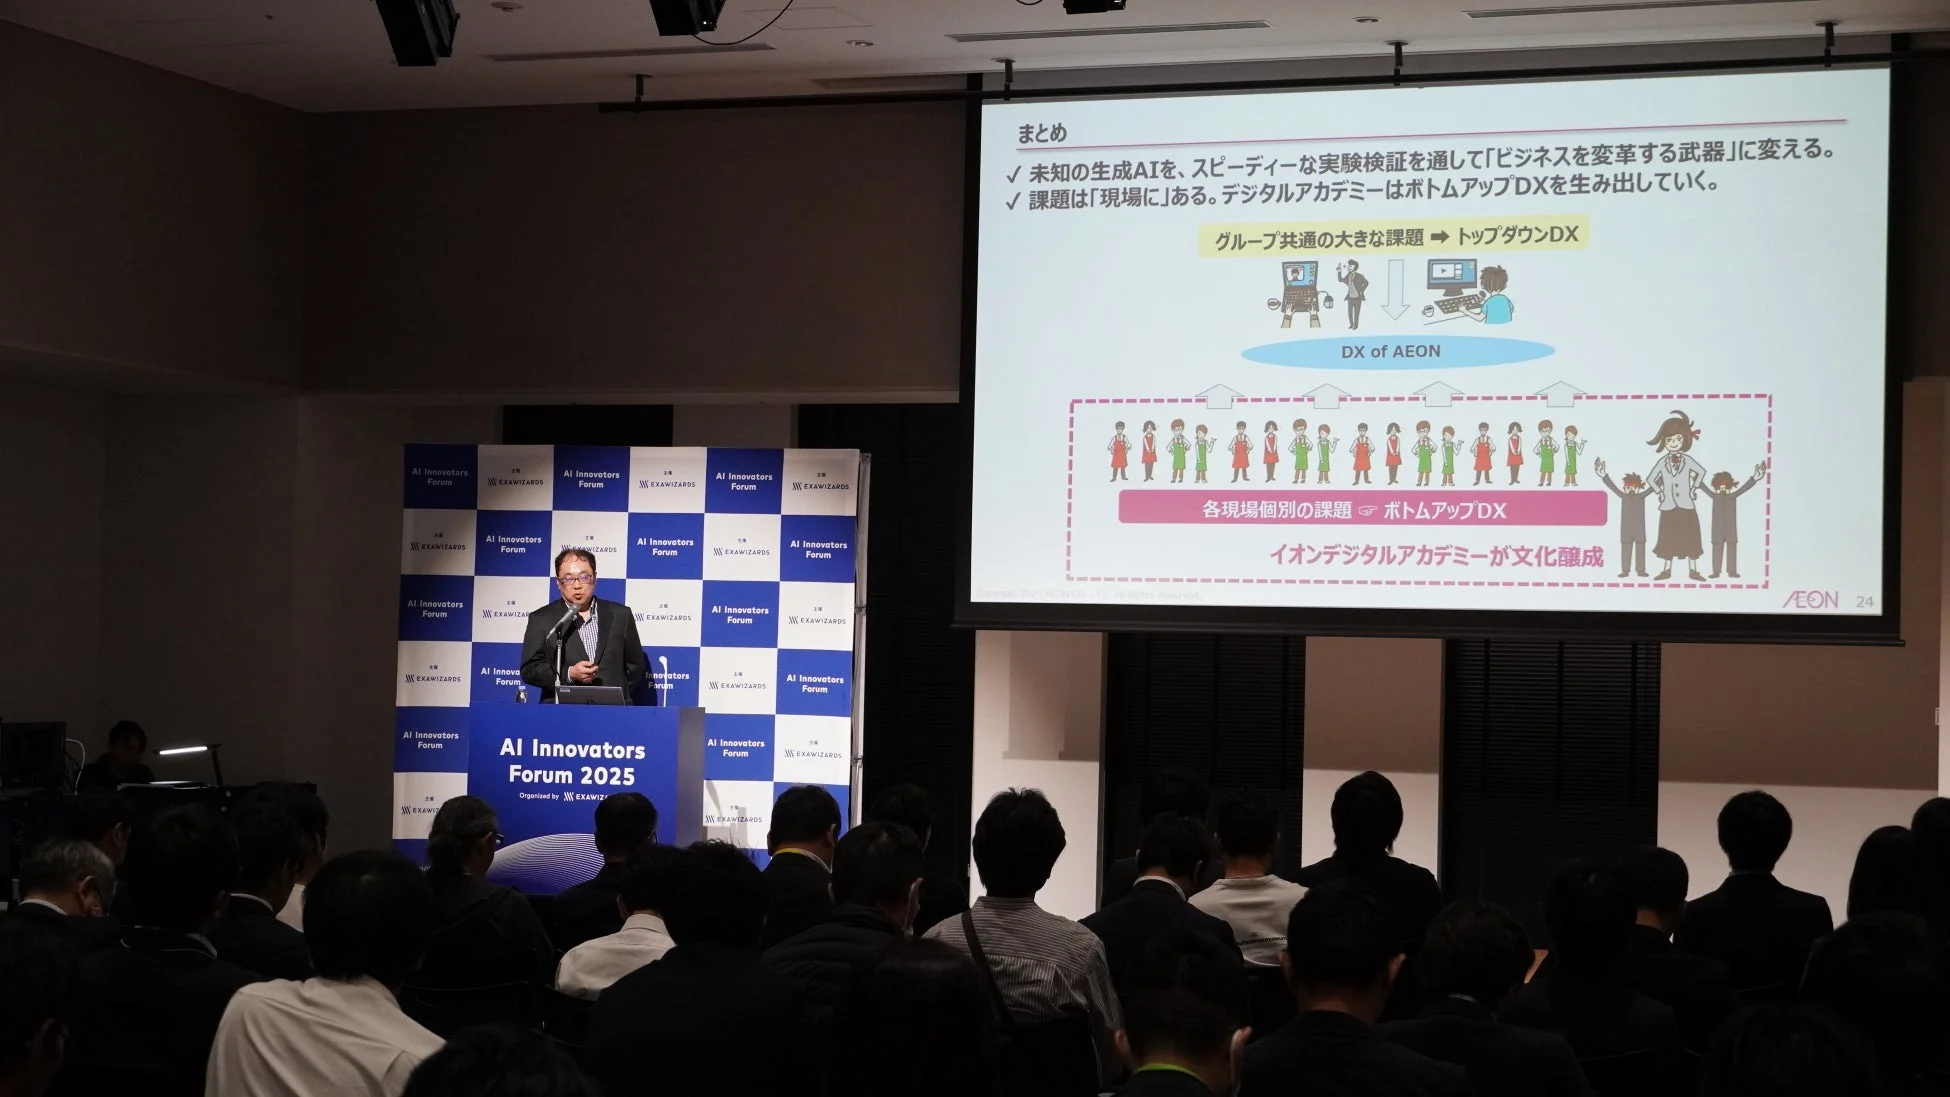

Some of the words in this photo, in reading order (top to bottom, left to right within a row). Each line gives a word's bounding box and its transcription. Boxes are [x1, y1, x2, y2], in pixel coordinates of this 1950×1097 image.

[1018, 123, 1067, 144] まとめ
[1215, 229, 1424, 251] グループ共通の大きな課題
[1458, 225, 1579, 246] トップダウンDX
[1342, 346, 1367, 359] DX
[1371, 345, 1388, 358] of
[1392, 344, 1441, 358] AEON
[412, 467, 421, 476] AI
[424, 468, 468, 477] Innovators
[563, 469, 573, 478] AI
[576, 470, 620, 479] Innovators
[715, 472, 725, 480] AI
[728, 472, 773, 481] Innovators
[427, 478, 453, 487] Forum
[578, 480, 604, 489] Forum
[731, 482, 757, 491] Forum
[1203, 500, 1352, 519] 各現場個別の課題
[1384, 500, 1507, 521] ボトムアップDX
[485, 535, 495, 543] AI
[498, 535, 542, 544] Innovators
[637, 538, 647, 546] AI
[649, 538, 694, 547] Innovators
[421, 543, 466, 551] EXAWIZARDS
[500, 545, 526, 553] Forum
[790, 540, 800, 548] AI
[803, 540, 848, 549] Innovators
[652, 548, 678, 556] Forum
[805, 550, 832, 559] Forum
[1270, 543, 1604, 568] イオンデジタルアカデミーが文化醸成
[407, 600, 417, 608] AI
[419, 600, 464, 609] Innovators
[1856, 596, 1874, 608] 24
[422, 610, 448, 618] Forum
[711, 606, 721, 614] AI
[724, 606, 769, 615] Innovators
[727, 616, 753, 624] Forum
[800, 617, 846, 625] EXAWIZARDS
[481, 667, 490, 675] AI
[493, 668, 521, 676] Innova
[496, 678, 521, 686] Forum
[786, 674, 796, 682] AI
[799, 674, 844, 684] Innovators
[802, 685, 828, 694] Forum
[403, 731, 412, 739] AI
[415, 731, 459, 740] Innovators
[418, 741, 443, 750] Forum
[707, 739, 717, 747] AI
[720, 739, 765, 748] Innovators
[500, 738, 522, 756] AI
[532, 738, 646, 760] Innovators
[723, 749, 749, 758] Forum
[796, 750, 842, 758] EXAWIZARDS
[509, 765, 573, 783] Forum
[581, 766, 635, 785] 2025
[519, 792, 550, 801] Organized
[551, 792, 559, 801] by
